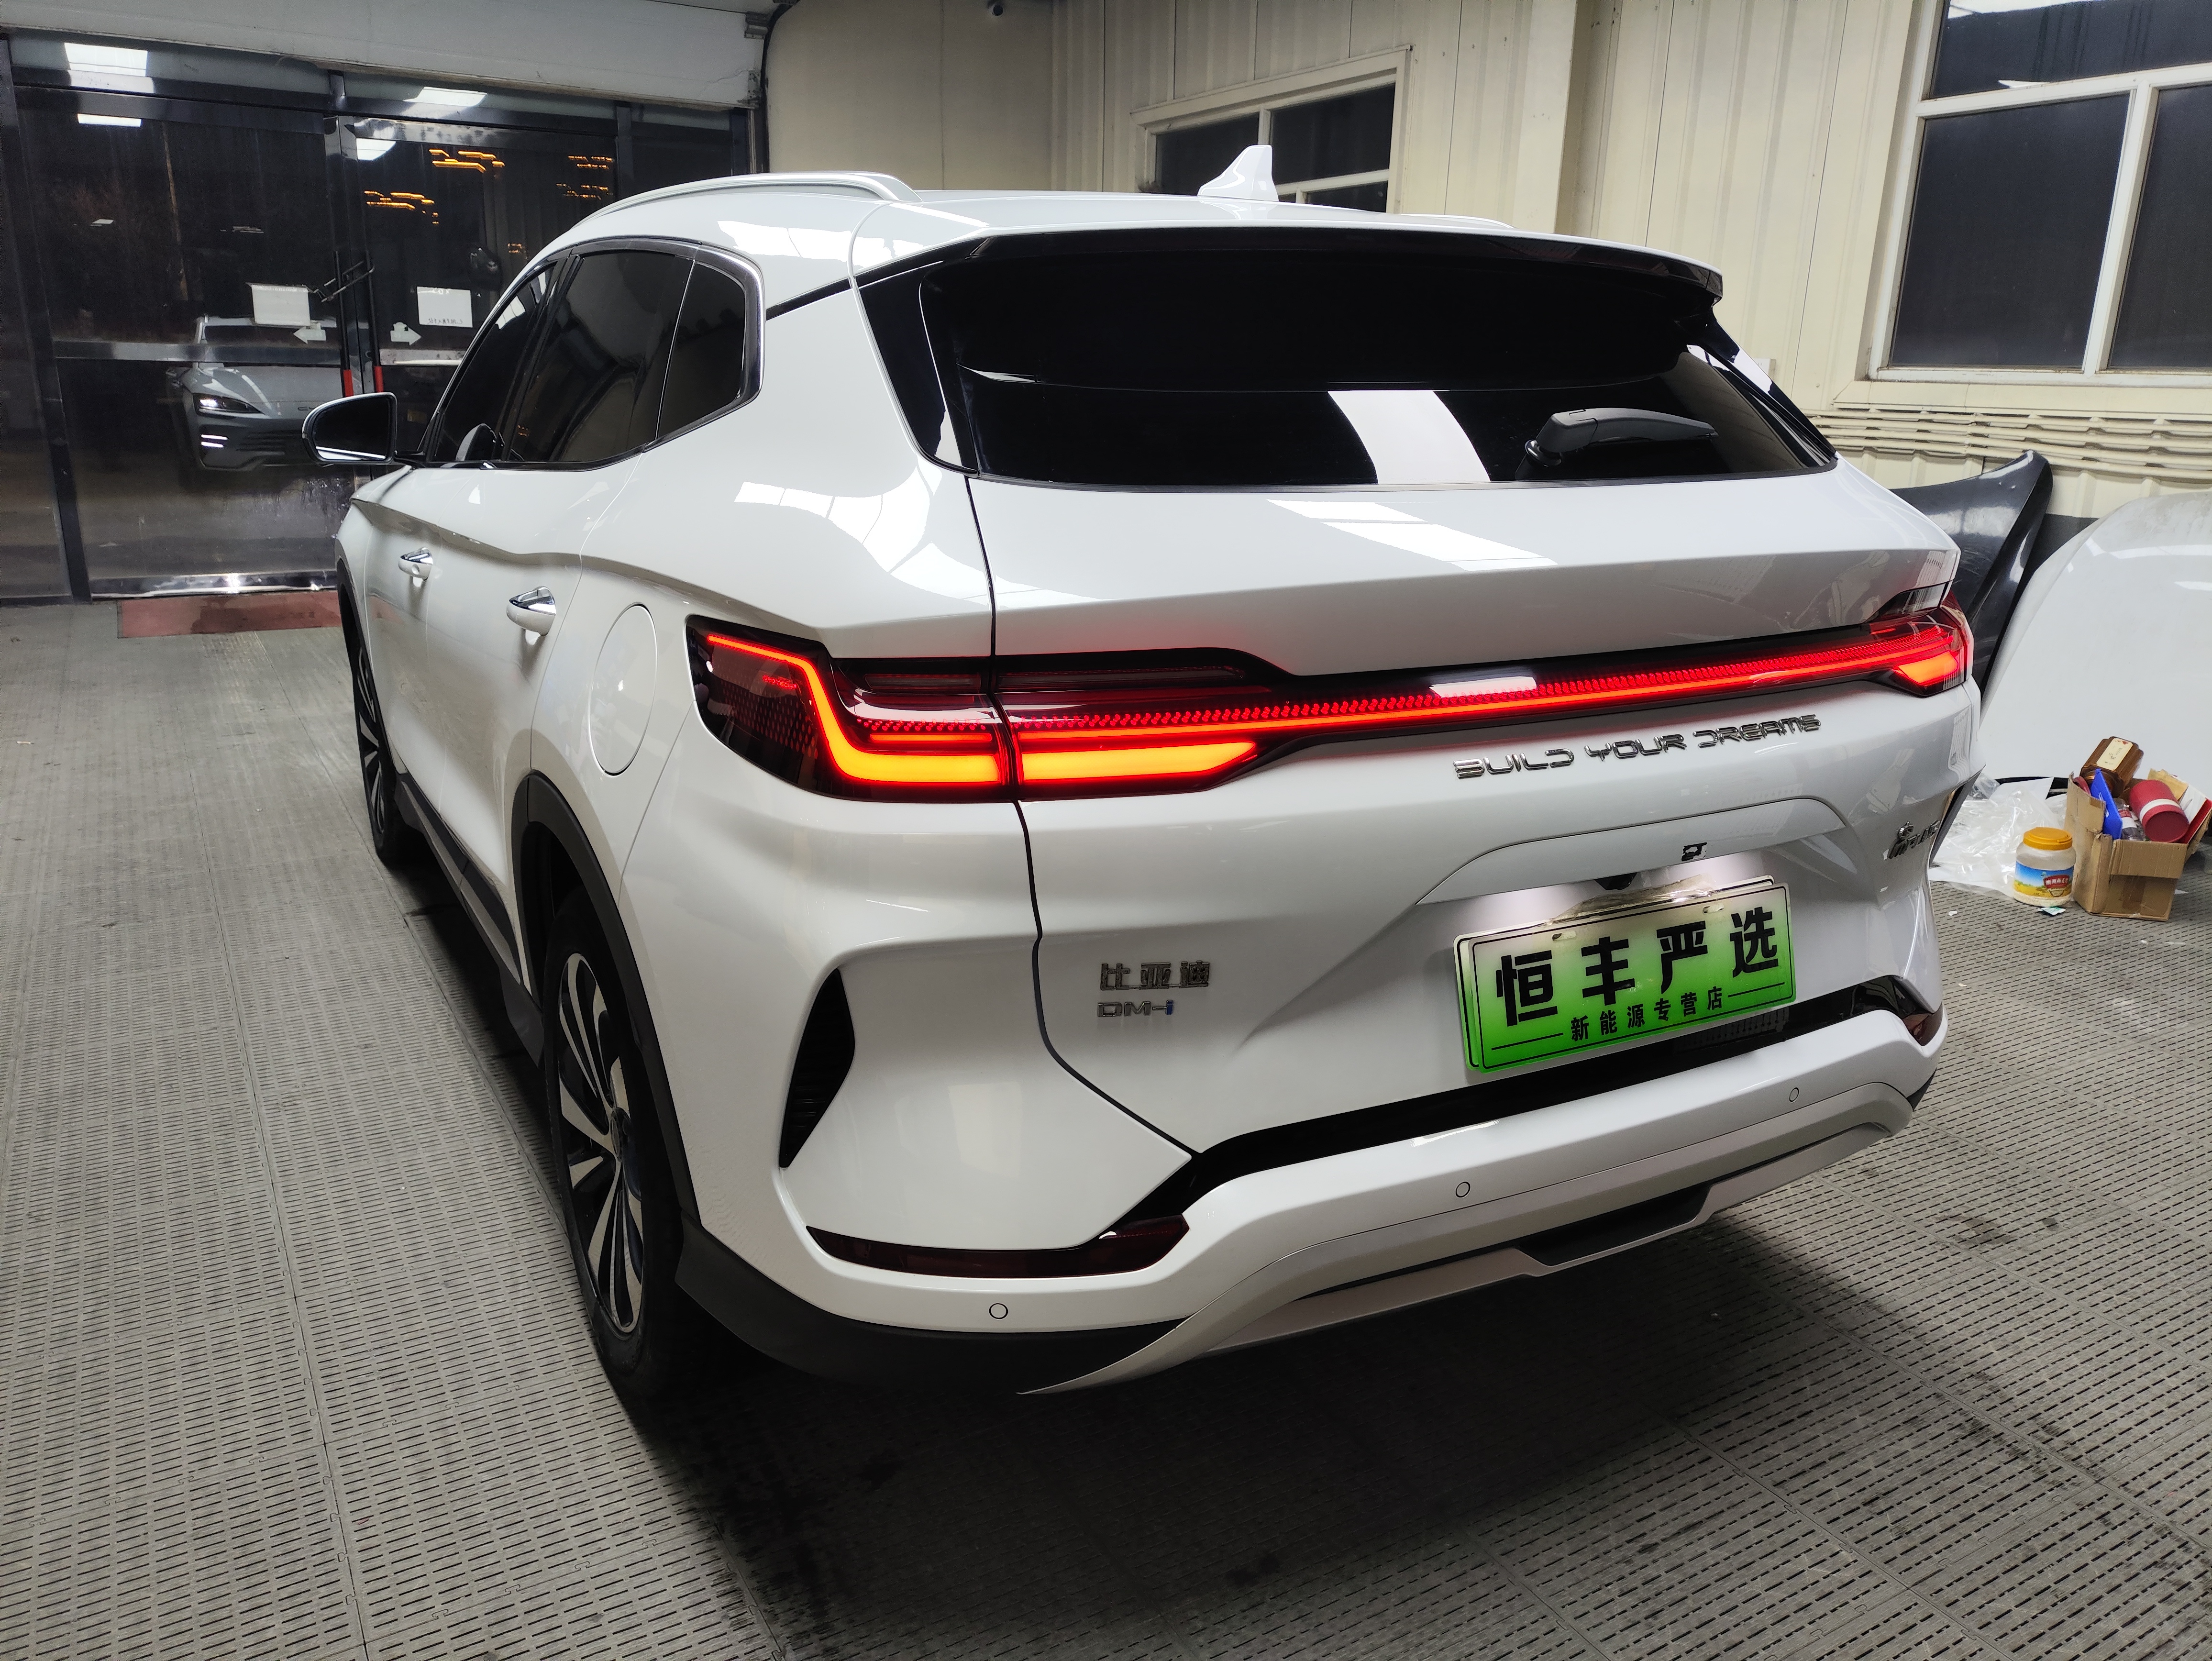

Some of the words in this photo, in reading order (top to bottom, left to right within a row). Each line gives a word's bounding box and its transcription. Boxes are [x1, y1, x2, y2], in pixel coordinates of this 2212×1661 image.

[1453, 748, 1575, 779] BUILD
[1584, 734, 1687, 762] YOUR
[1692, 714, 1822, 748] DREAMS
[1100, 960, 1210, 991] 比亚迪
[1496, 906, 1779, 1027] 恒丰严选
[1097, 999, 1173, 1018] DM-i
[1571, 986, 1723, 1041] 新能源专营店
